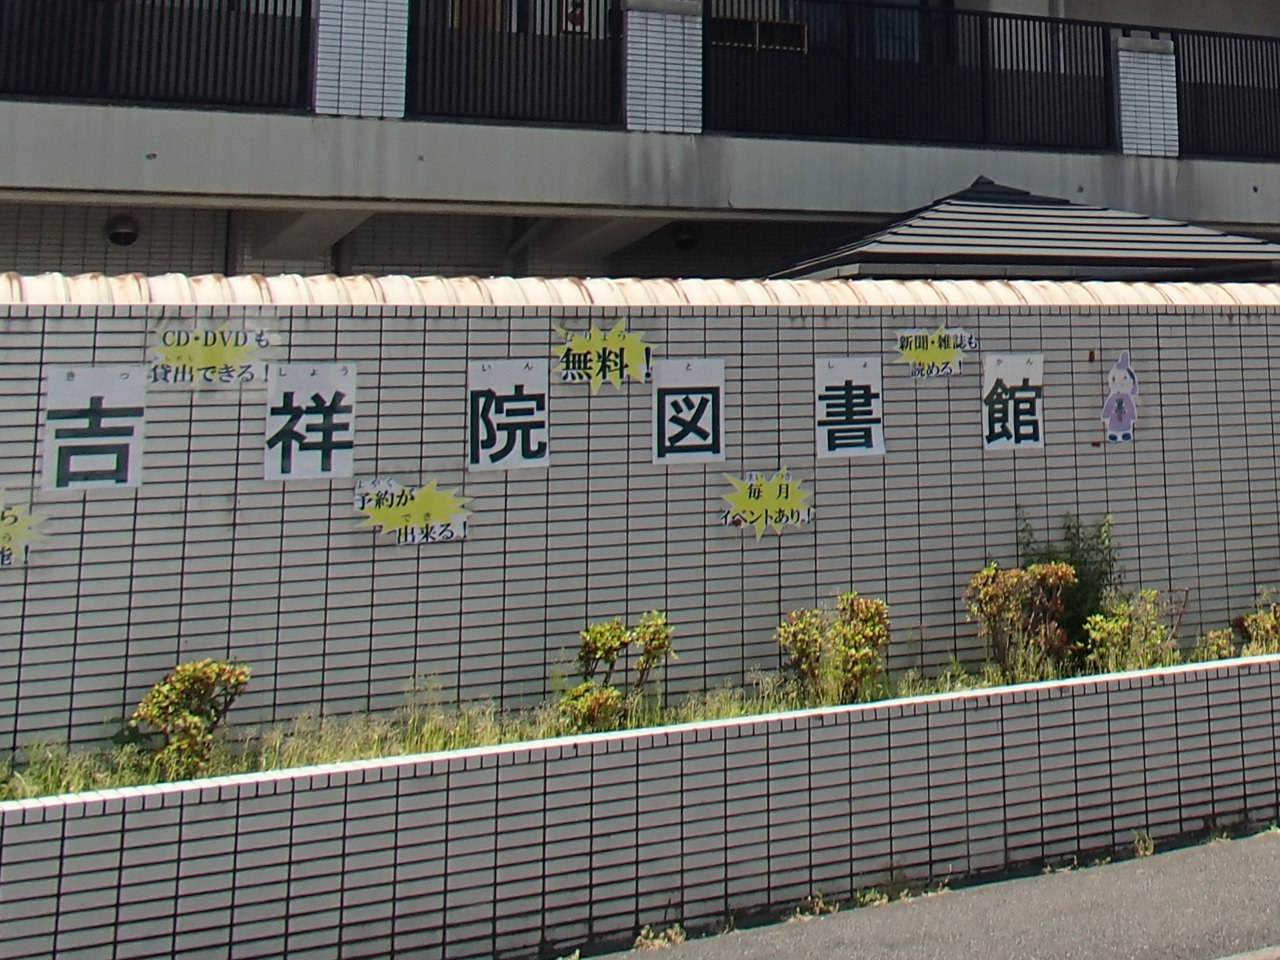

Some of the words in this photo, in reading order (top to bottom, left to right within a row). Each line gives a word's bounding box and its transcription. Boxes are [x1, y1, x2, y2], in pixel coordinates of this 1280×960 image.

[899, 334, 978, 351] 新聞・雑誌も
[152, 363, 269, 383] 貸出できる!
[560, 346, 652, 381] 無料!
[910, 360, 963, 377] 読める!
[356, 488, 415, 510] 予約が
[720, 507, 811, 526] イベントあり!
[397, 521, 468, 544] 出来る!
